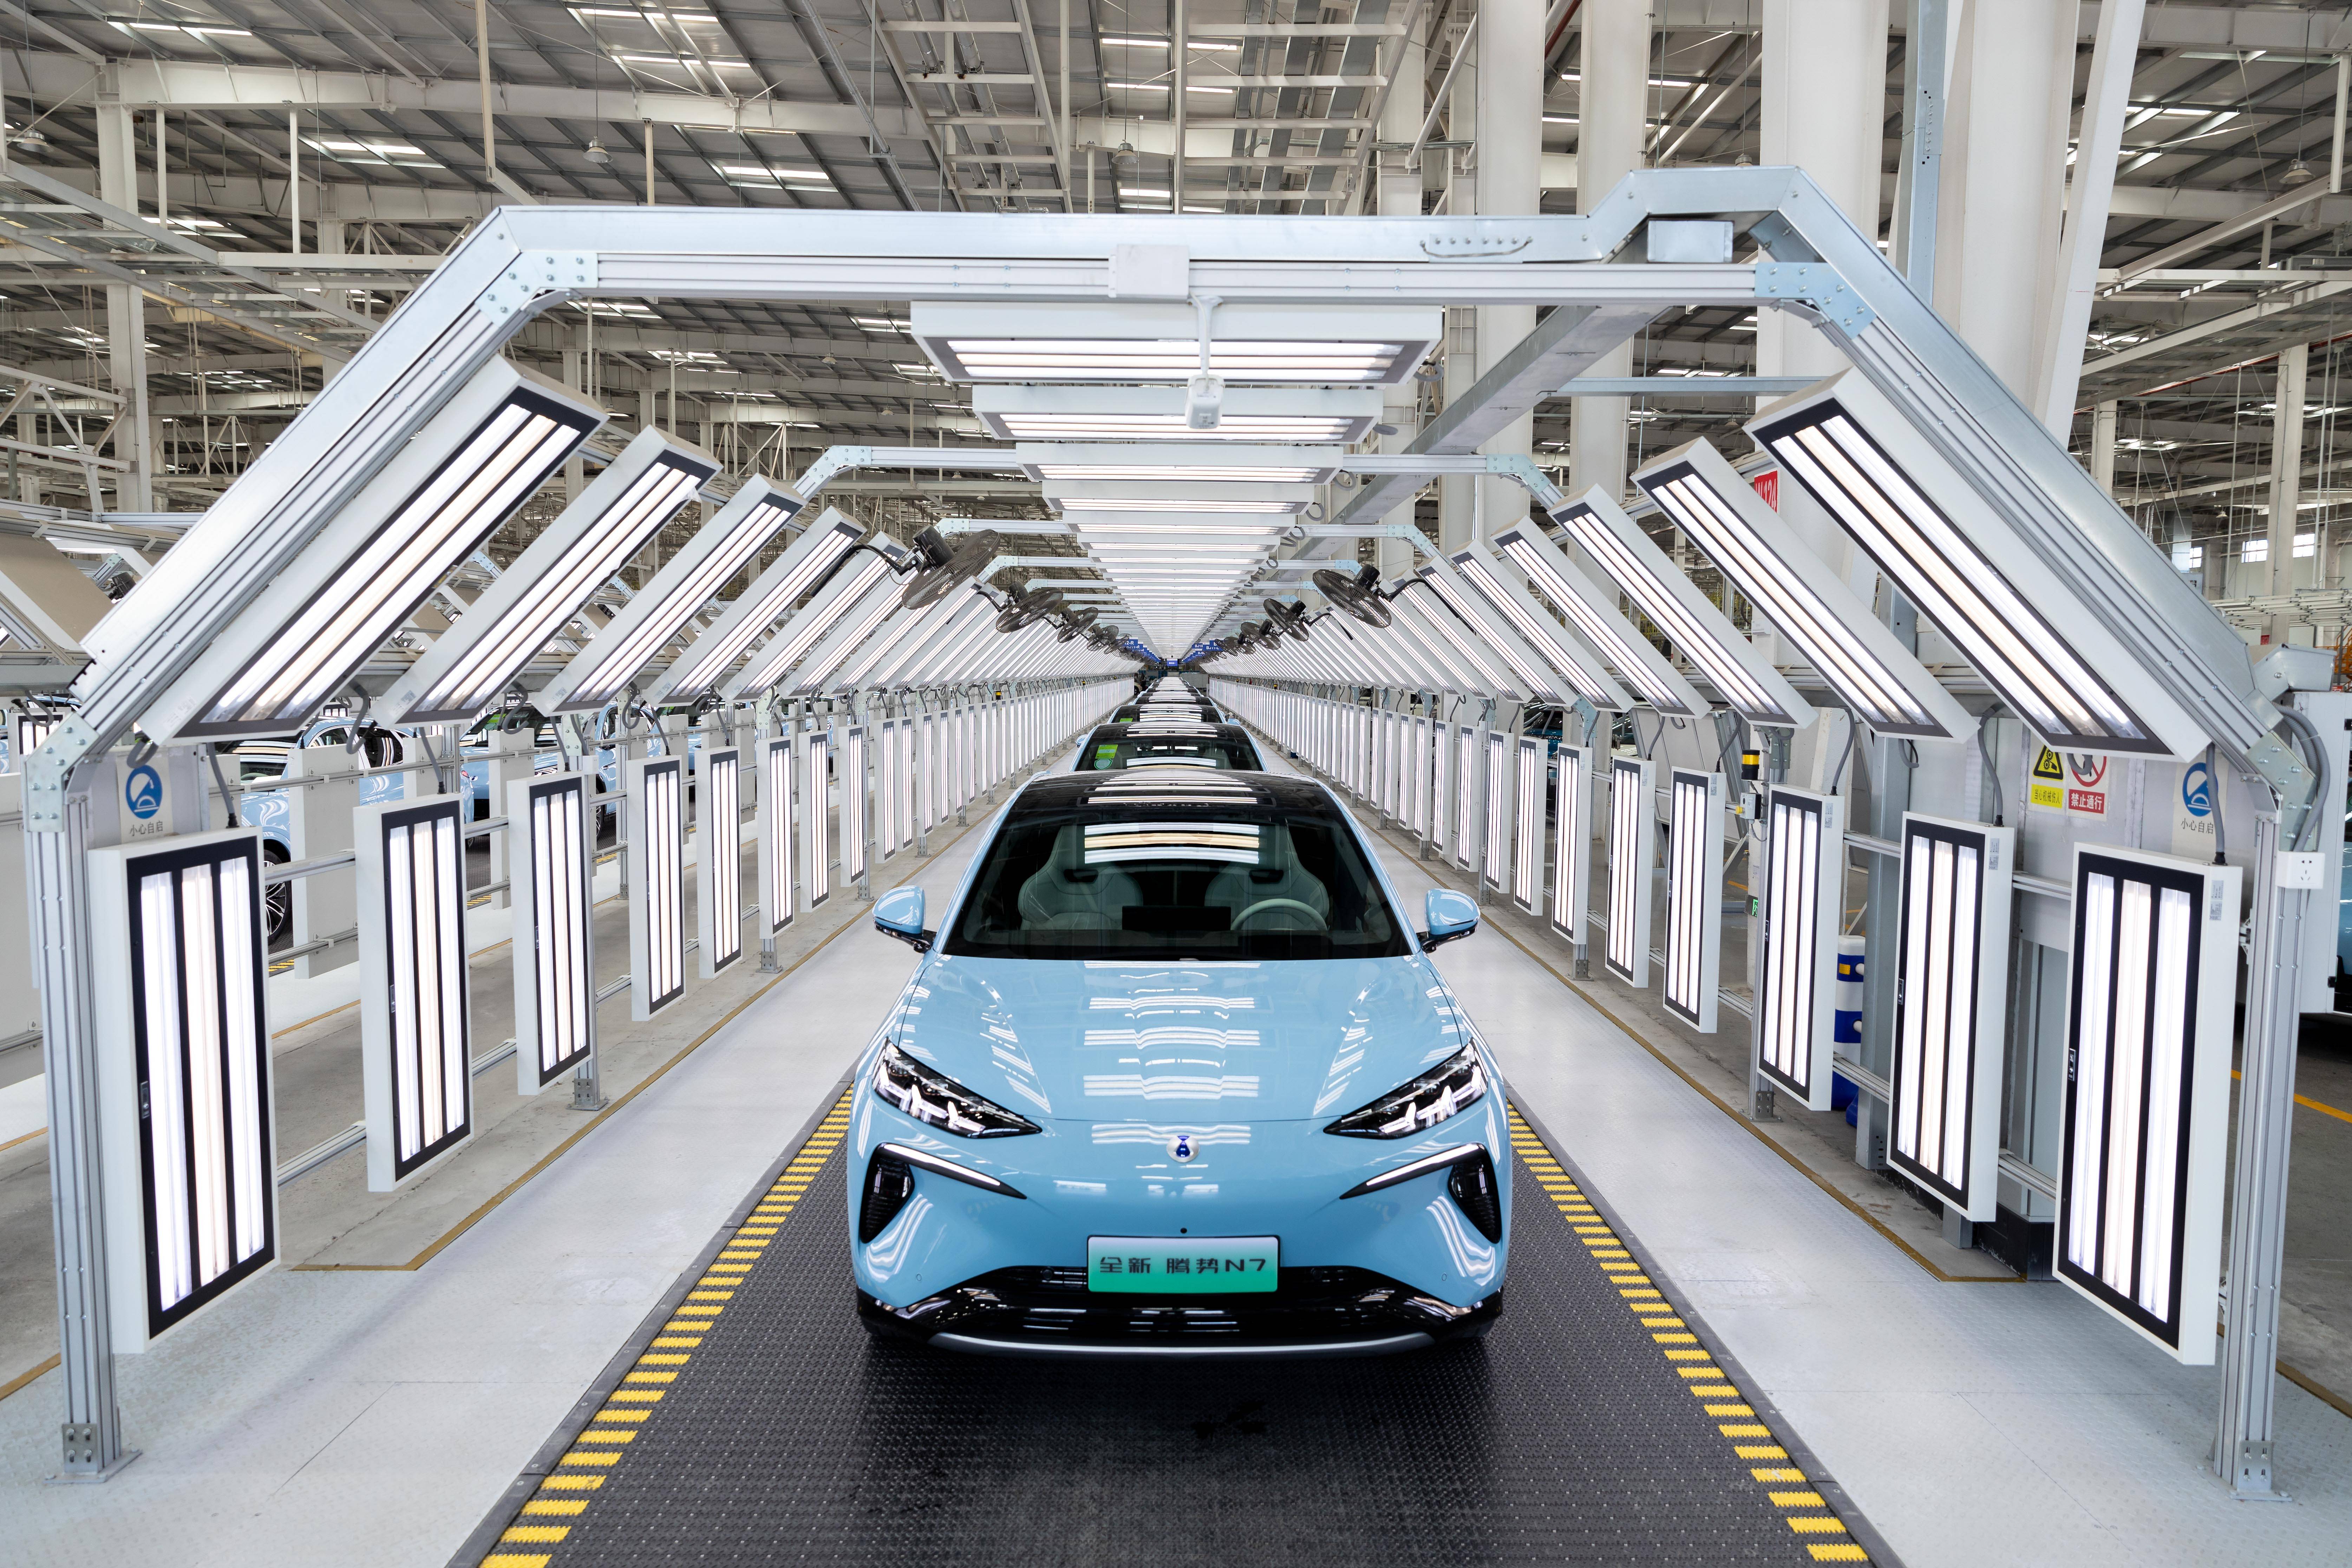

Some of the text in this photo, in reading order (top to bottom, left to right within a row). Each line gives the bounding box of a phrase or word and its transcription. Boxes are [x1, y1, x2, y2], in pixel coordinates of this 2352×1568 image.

[2034, 789, 2060, 804] 当心机械伤人
[2071, 792, 2102, 810] 禁止通行
[129, 820, 163, 836] 小心自启
[2181, 818, 2214, 835] 小心自启
[1100, 1257, 1266, 1274] 全新 腾势N7
